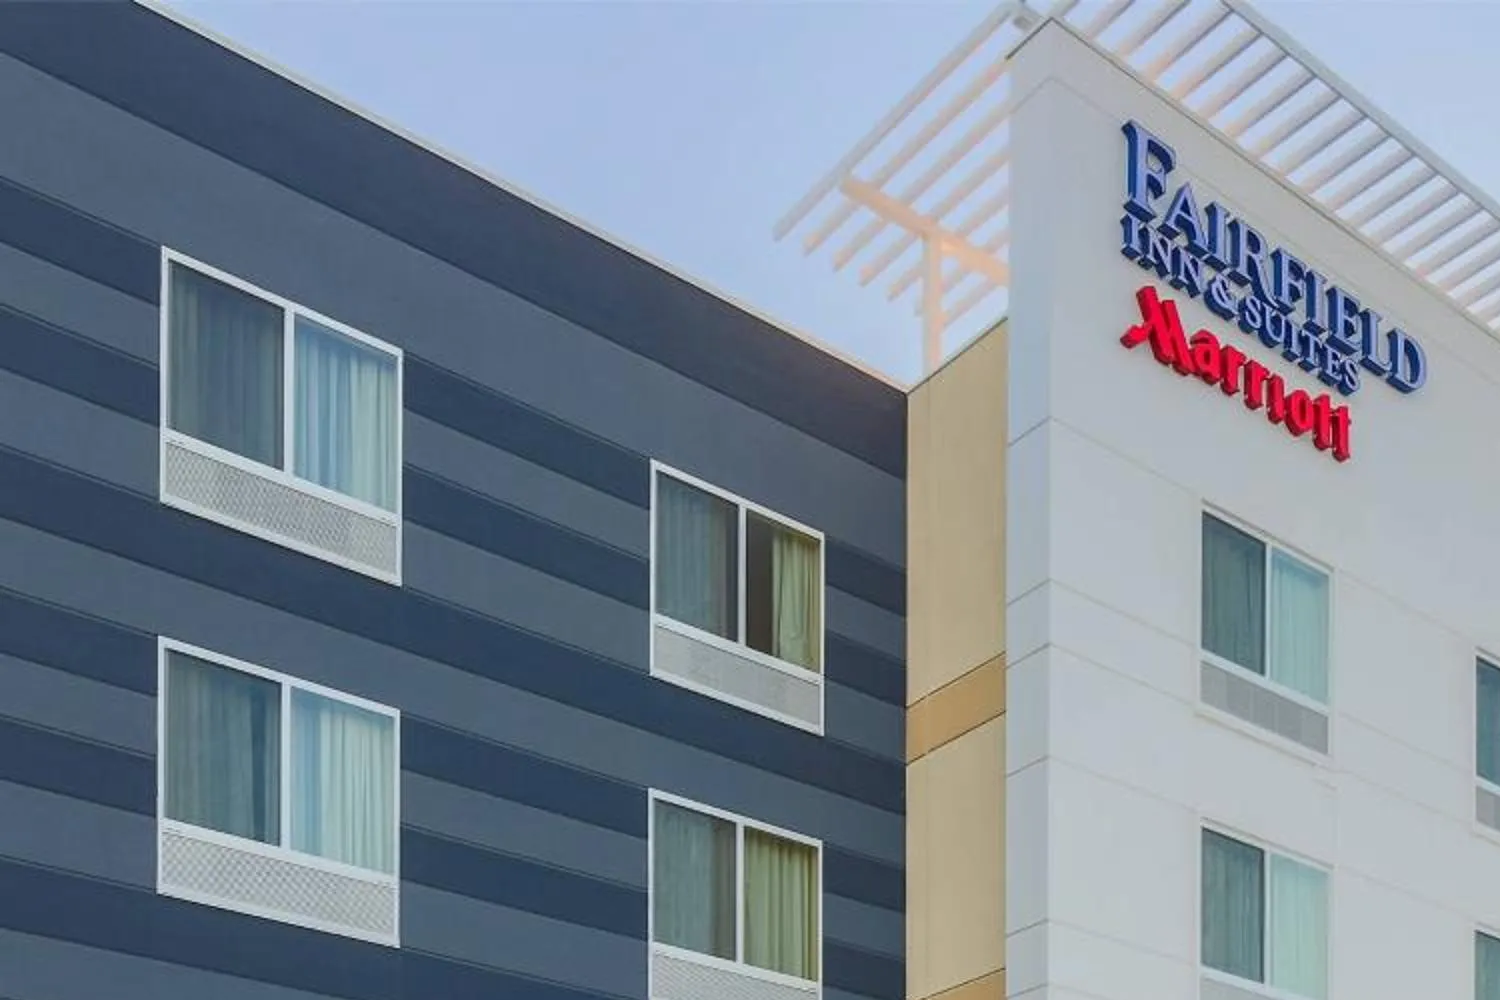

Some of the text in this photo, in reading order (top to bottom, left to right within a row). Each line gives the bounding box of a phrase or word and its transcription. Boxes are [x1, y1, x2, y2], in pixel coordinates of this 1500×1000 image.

[1120, 213, 1202, 299] INN
[1237, 295, 1361, 397] SUITES
[1121, 118, 1428, 394] FAIRFIELD
[1120, 285, 1352, 463] Marriott
